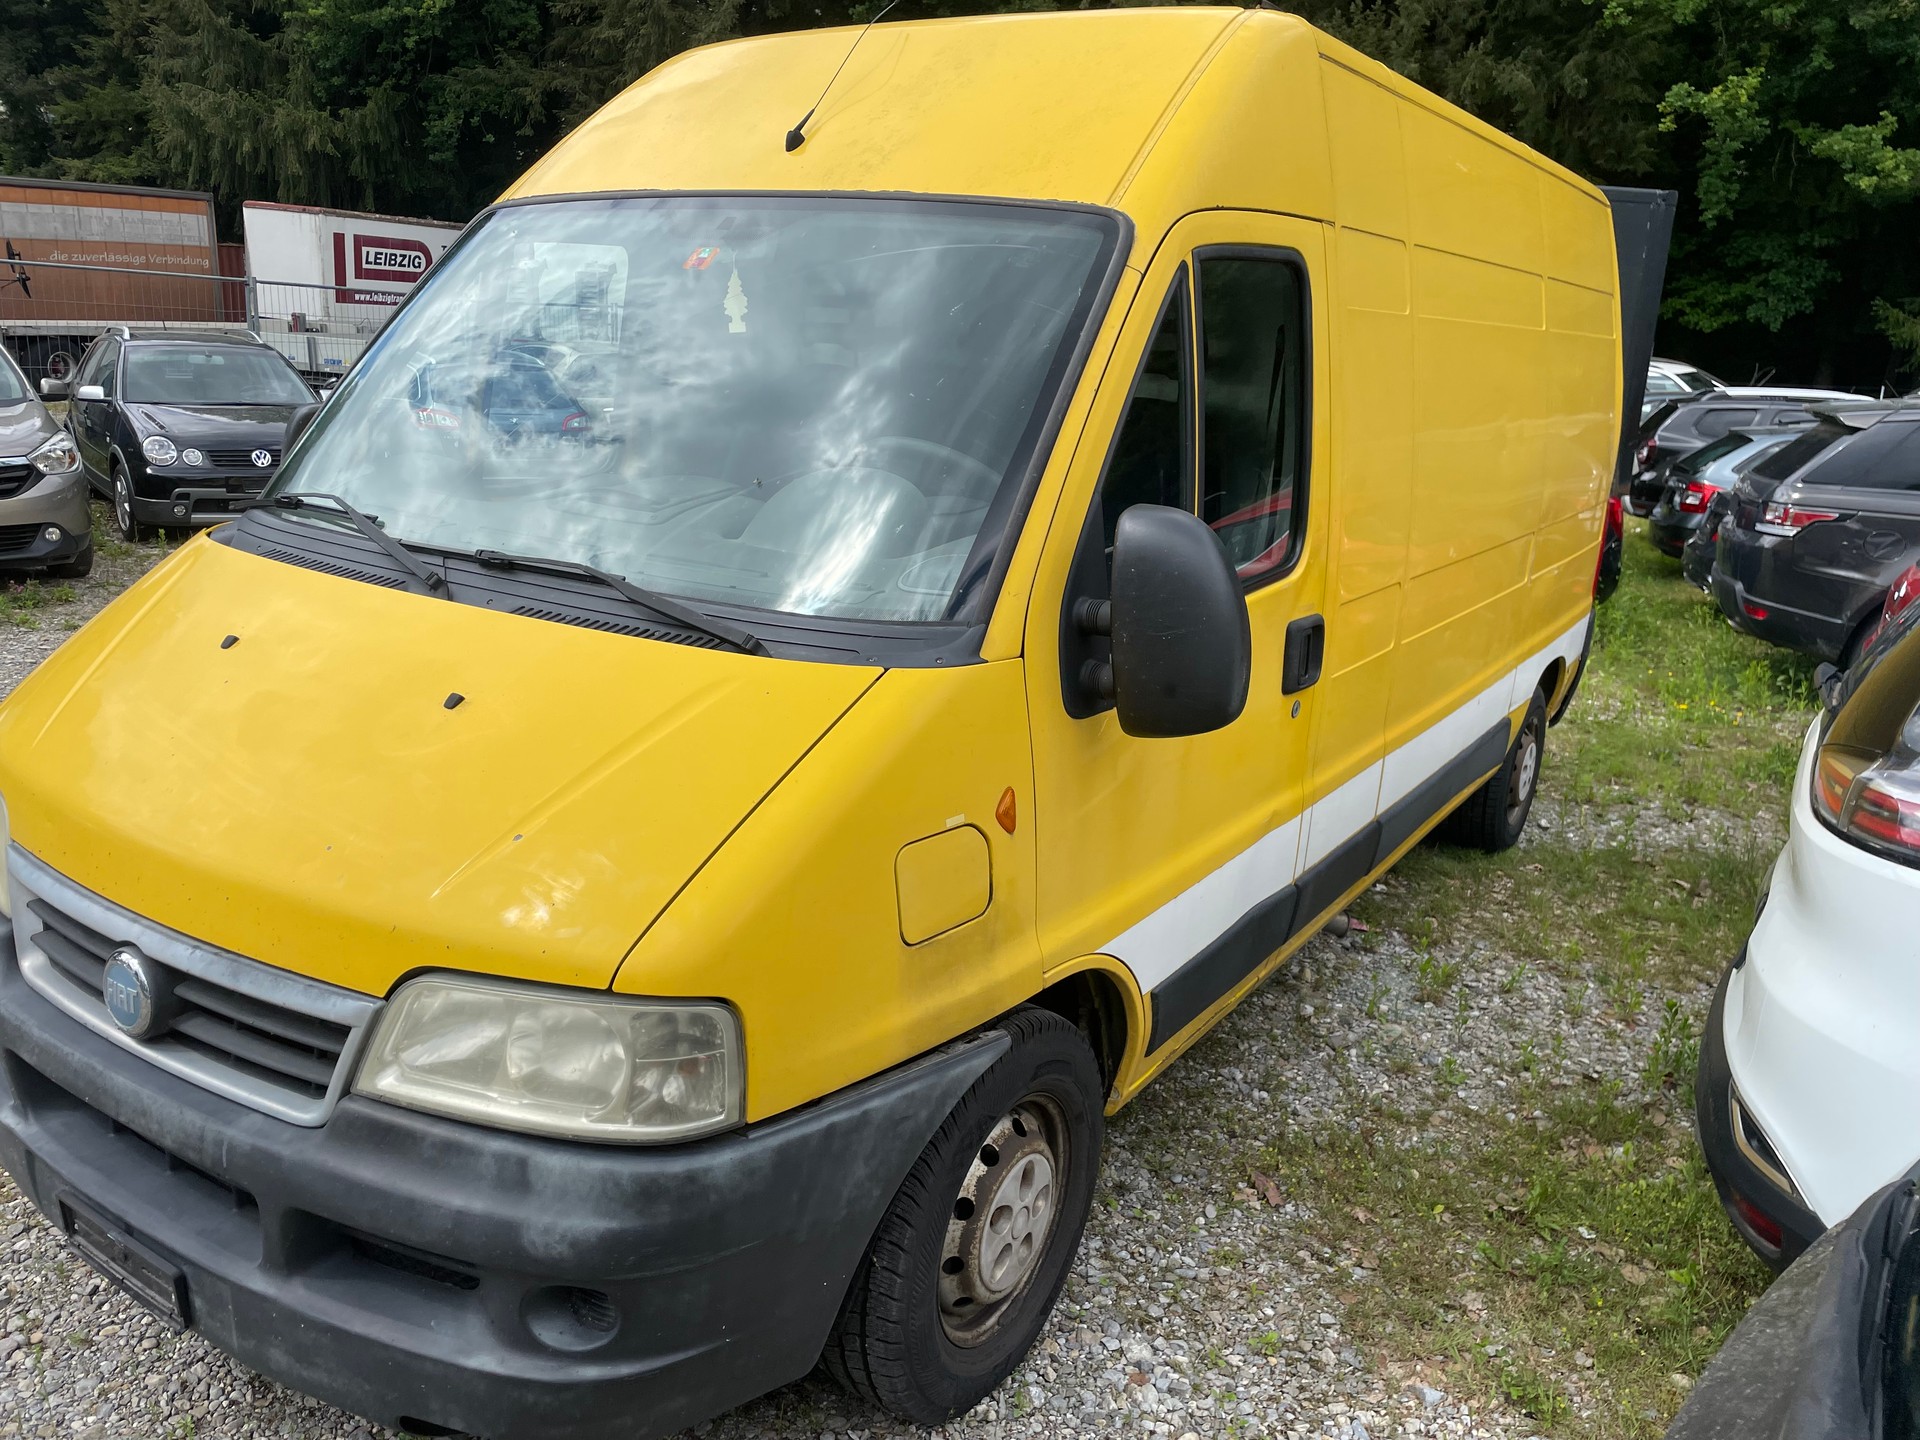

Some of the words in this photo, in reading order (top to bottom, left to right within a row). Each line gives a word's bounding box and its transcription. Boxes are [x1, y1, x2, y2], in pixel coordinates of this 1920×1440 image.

[49, 251, 69, 261] die
[71, 252, 146, 266] zuverlässige
[148, 254, 209, 269] Verbindung
[364, 250, 422, 269] LEIBZIG
[251, 449, 272, 467] VW
[107, 977, 137, 1013] FIAT
